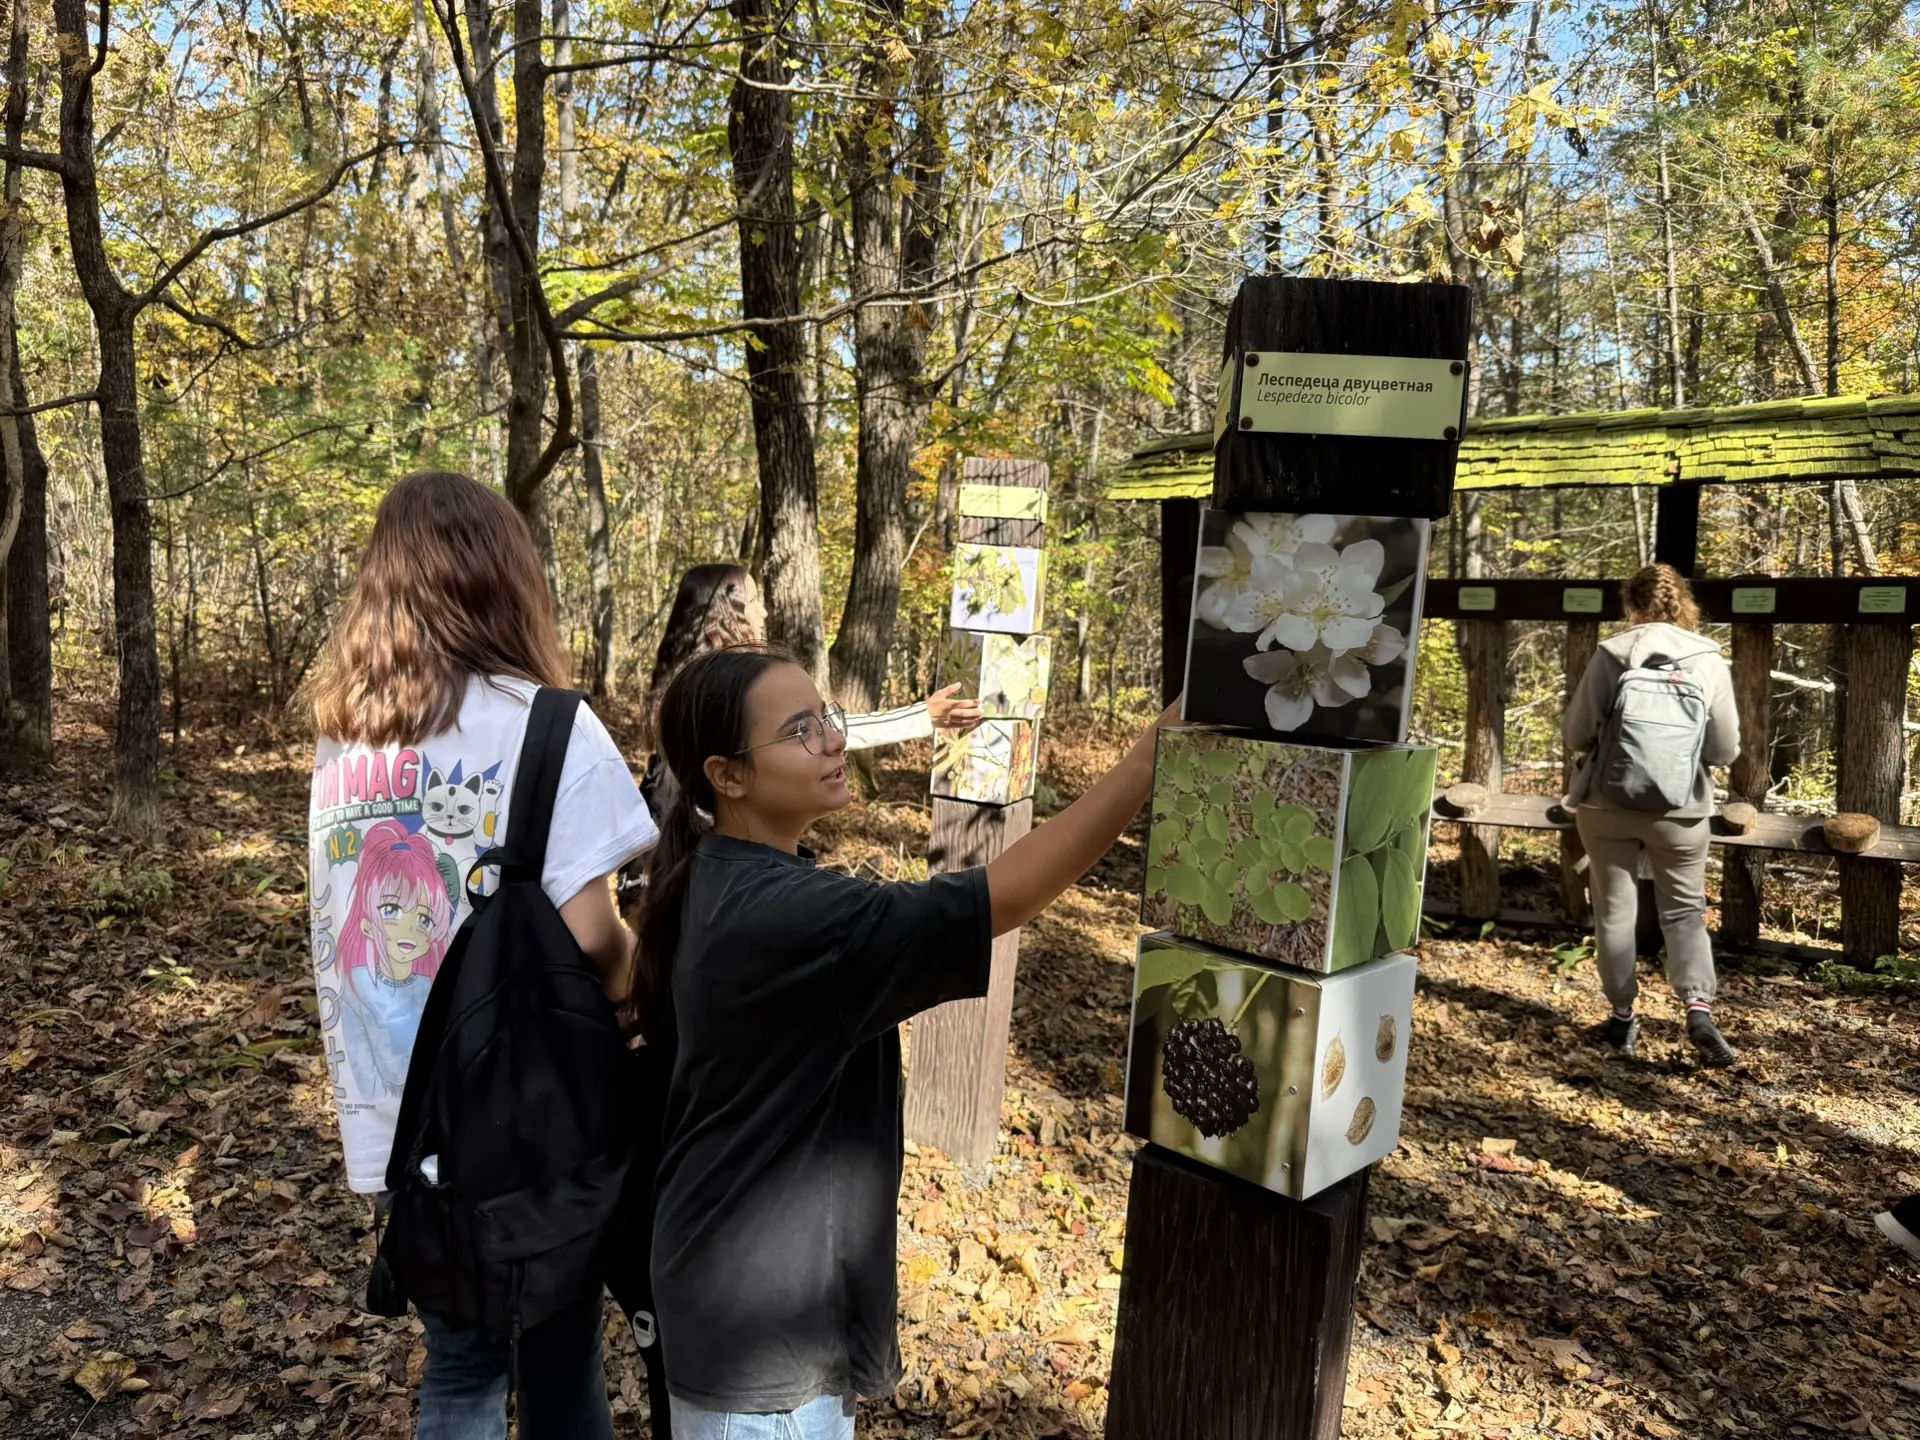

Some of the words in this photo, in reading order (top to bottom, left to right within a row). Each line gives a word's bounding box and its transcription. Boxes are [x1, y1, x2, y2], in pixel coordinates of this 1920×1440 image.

[1258, 373, 1339, 391] Леспедеца
[1342, 378, 1433, 393] двуцветная
[1257, 389, 1323, 406] Lespedeza
[1326, 391, 1371, 406] bicolor
[343, 749, 420, 804] MAG
[346, 805, 362, 819] HAVE
[364, 804, 371, 816] A
[372, 801, 393, 815] GOOD
[395, 799, 420, 812] TIME
